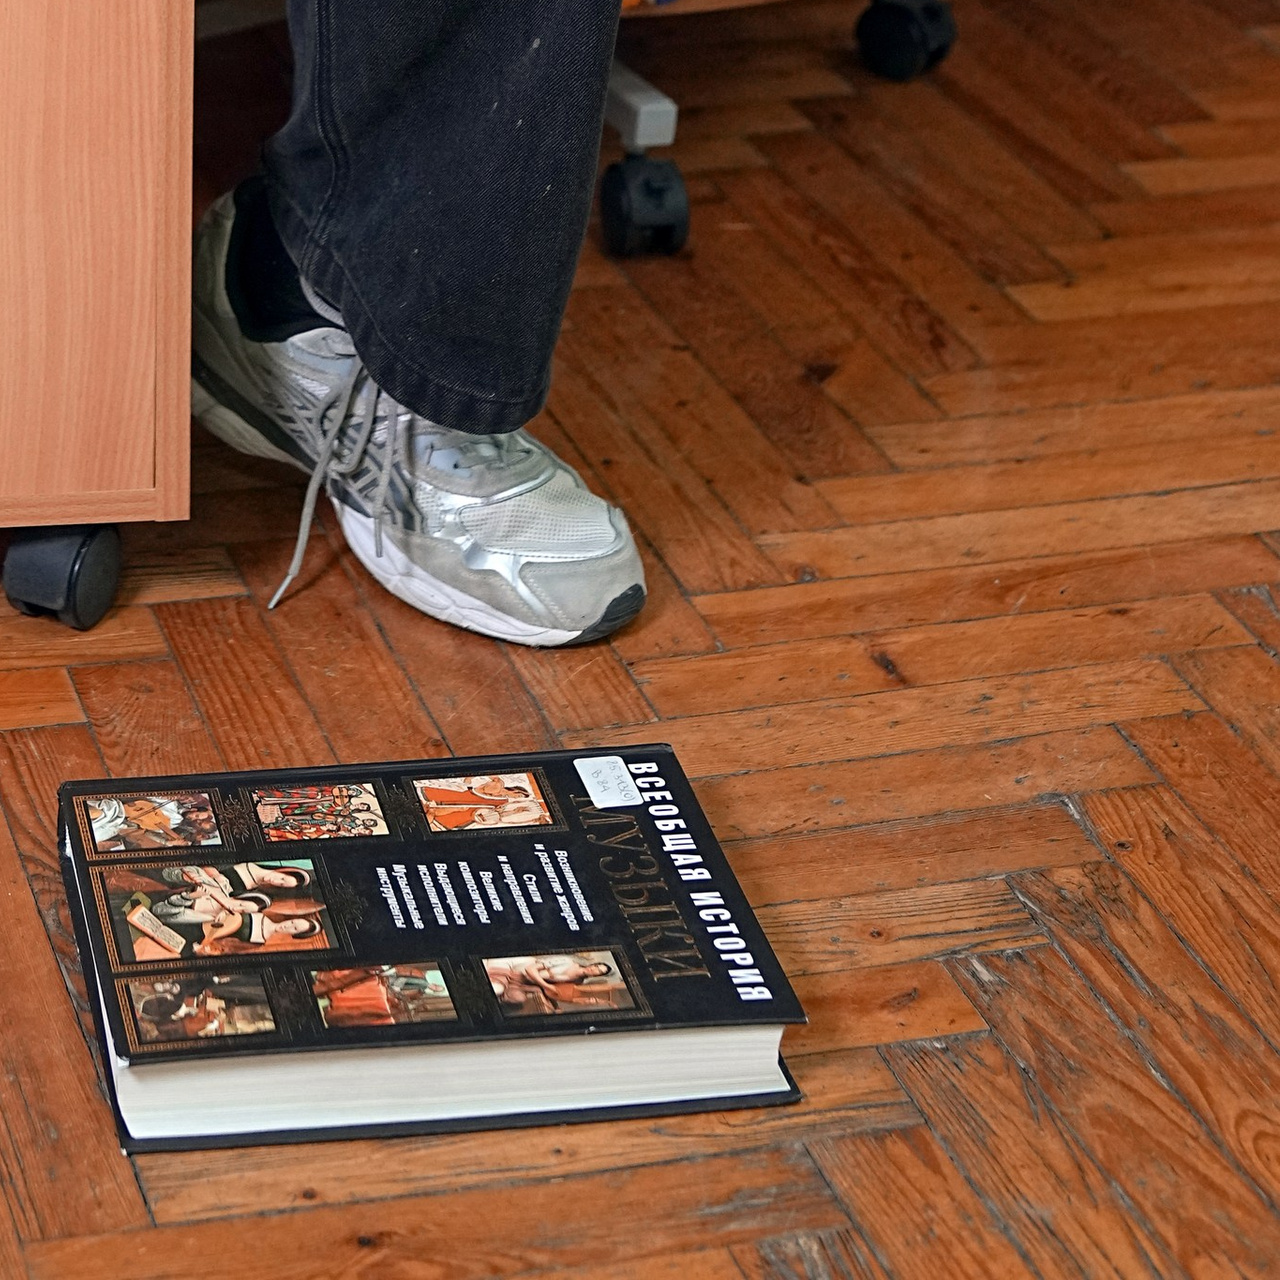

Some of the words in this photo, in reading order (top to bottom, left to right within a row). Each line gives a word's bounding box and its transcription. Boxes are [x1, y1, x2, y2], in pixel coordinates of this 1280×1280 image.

[375, 867, 407, 929] инструменты
[392, 864, 425, 930] Музыкальные
[416, 864, 449, 926] исполнители
[433, 862, 467, 926] Выдающиеся
[457, 861, 491, 924] композиторы
[478, 870, 504, 912] Великие
[500, 863, 535, 925] направления
[523, 873, 543, 903] Стили
[534, 851, 563, 894] развитие
[555, 894, 580, 931] жанров
[554, 850, 594, 922] Возникновение
[627, 762, 712, 882] ВСЕОБЩАЯ
[689, 891, 773, 1002] ИСТОРИЯ
